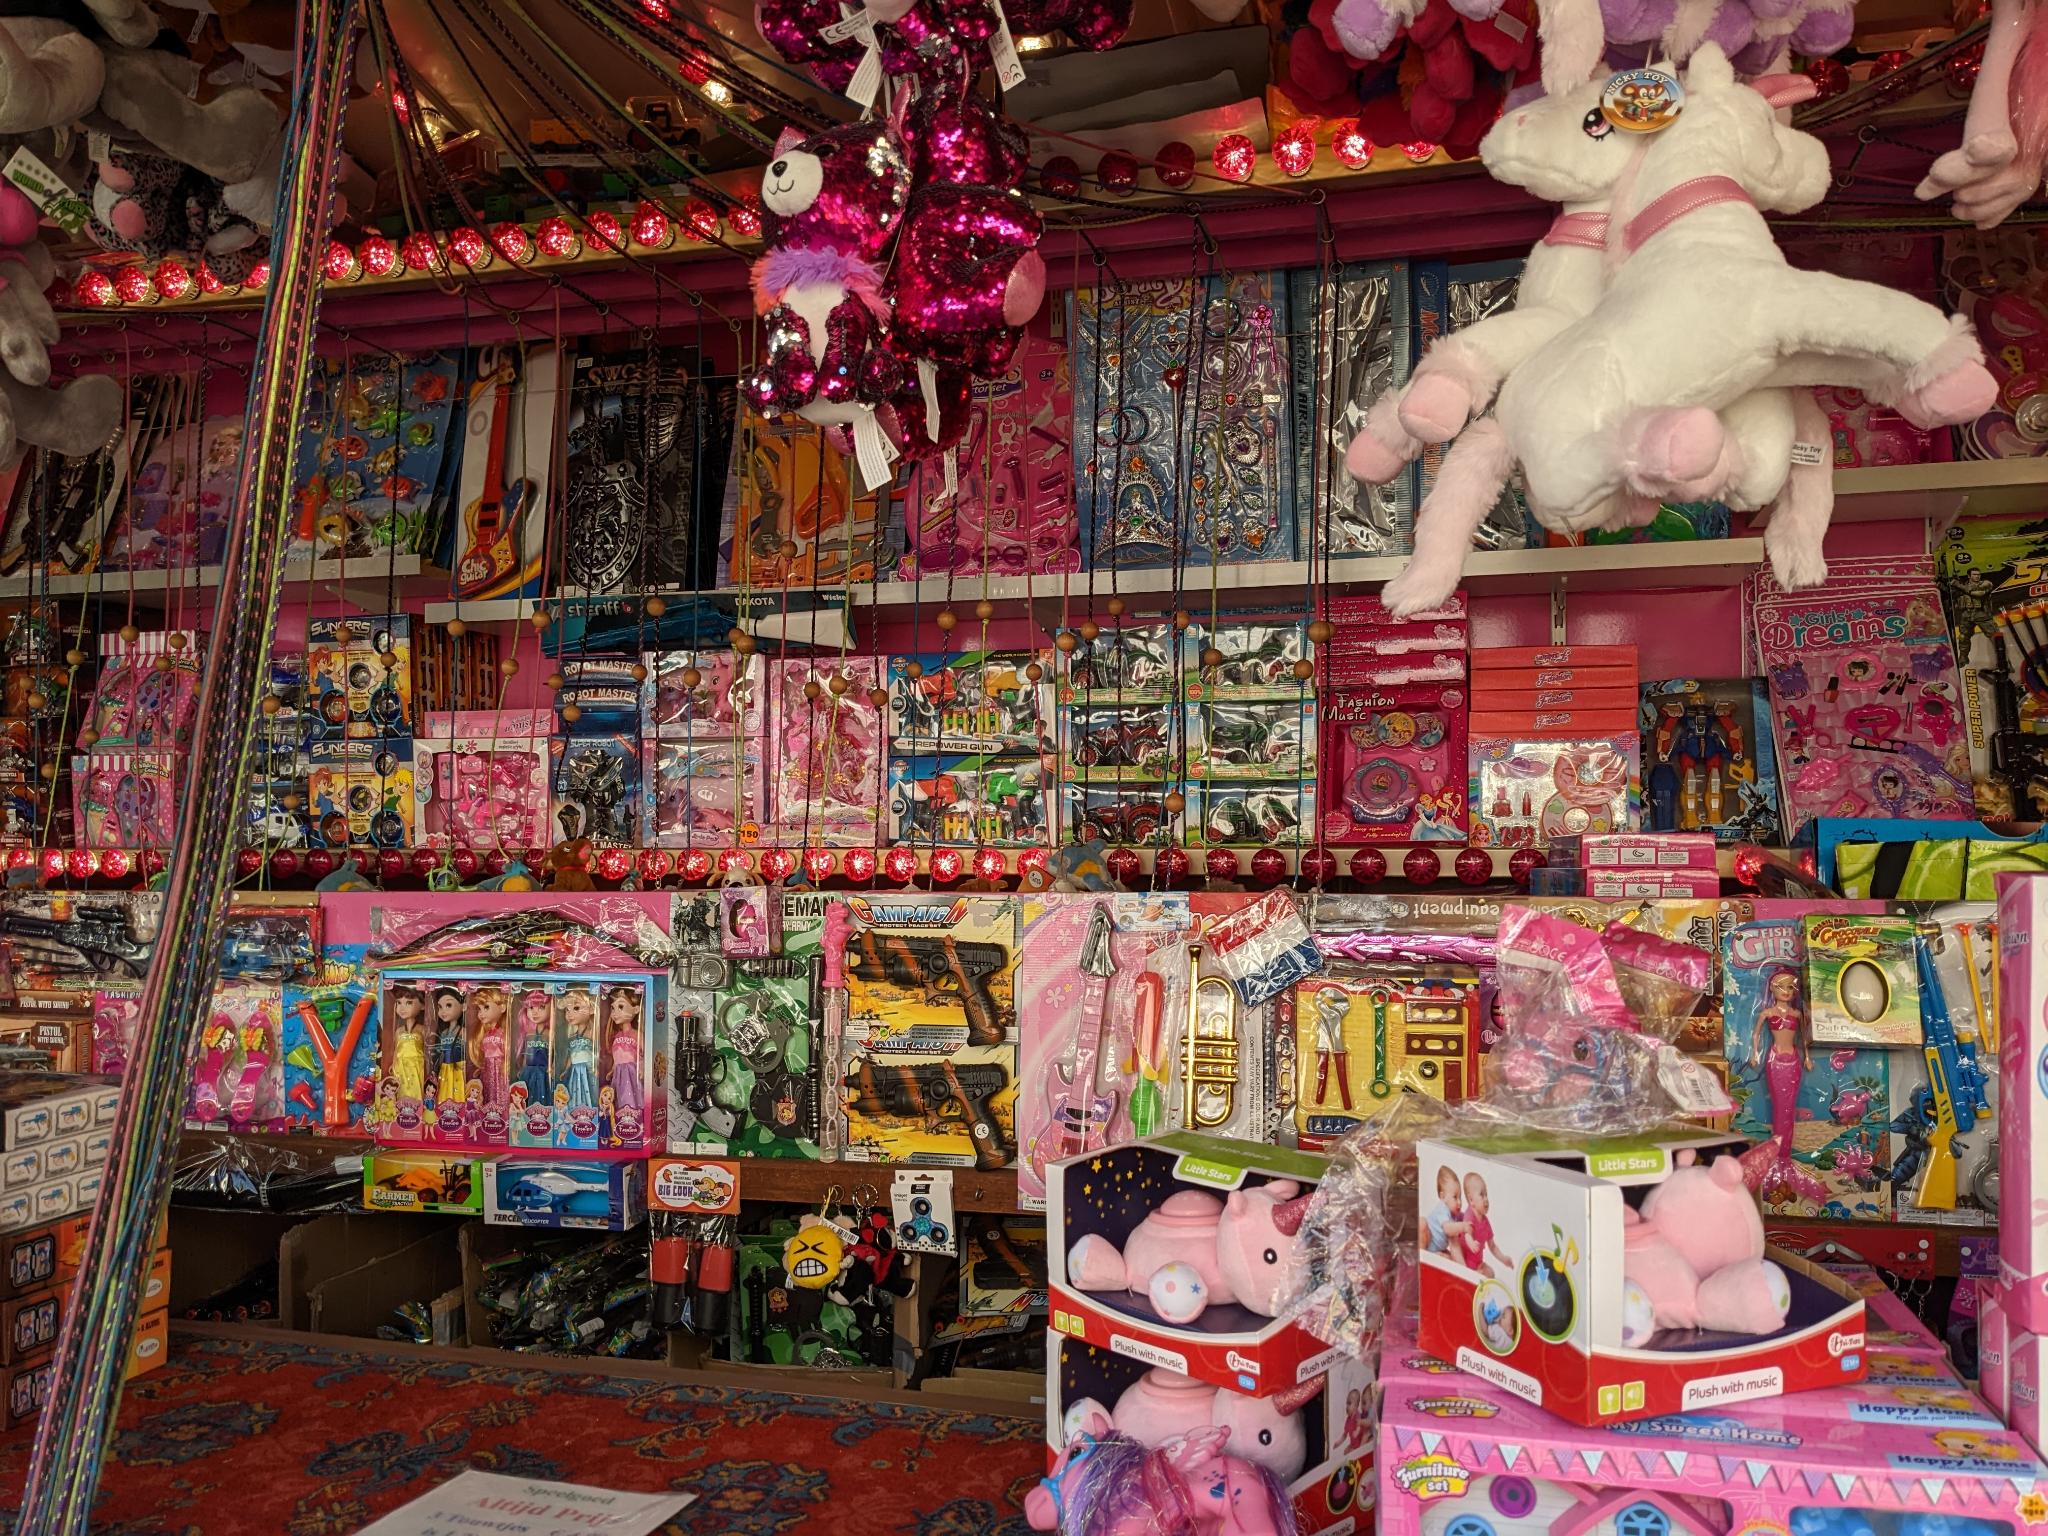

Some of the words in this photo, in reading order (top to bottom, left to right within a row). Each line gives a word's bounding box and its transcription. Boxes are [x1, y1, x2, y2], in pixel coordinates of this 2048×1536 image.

[1607, 72, 1640, 95] NICKY
[1644, 73, 1668, 83] TOY
[735, 597, 775, 606] DAKOTA
[1762, 616, 1908, 650] Dreams
[564, 662, 598, 677] ROBOT
[601, 661, 640, 673] MASTE
[562, 689, 597, 704] ROBOT
[598, 688, 638, 703] MASTER
[1965, 668, 1981, 709] POWER
[1970, 711, 1985, 750] SUPER
[907, 740, 969, 750] FIREPOWER
[970, 742, 993, 752] GUN
[741, 830, 759, 839] 150
[847, 897, 971, 925] CAMPAIGN
[1412, 898, 1500, 920] equipment
[1760, 928, 1793, 940] FISH
[1819, 926, 1881, 944] CROCODILE
[40, 1026, 62, 1036] PISTOL
[1184, 1163, 1207, 1175] Little
[1207, 1168, 1233, 1181] Stars
[1598, 1160, 1626, 1172] Little
[1628, 1158, 1658, 1169] Stars
[658, 1184, 671, 1195] BIG
[1114, 1340, 1137, 1356] Plush
[1138, 1349, 1156, 1361] with
[1157, 1355, 1184, 1370] music
[1300, 1360, 1321, 1378] Plush
[1320, 1354, 1336, 1368] with
[1461, 1354, 1486, 1375] Plush
[1488, 1368, 1507, 1385] with
[1508, 1377, 1537, 1399] music
[1688, 1385, 1718, 1401] Plush
[1721, 1380, 1744, 1395] with
[1746, 1375, 1778, 1391] music
[1858, 1403, 1920, 1415] Happy
[1927, 1406, 1982, 1416] Home
[1647, 1421, 1724, 1438] Sweet
[1728, 1427, 1804, 1447] Home
[1898, 1455, 1965, 1467] Happy
[1973, 1458, 2031, 1469] Home
[1396, 1461, 1470, 1490] Furniture
[526, 1484, 617, 1506] Speelgoed
[1427, 1478, 1450, 1493] set
[471, 1496, 550, 1517] Altijd
